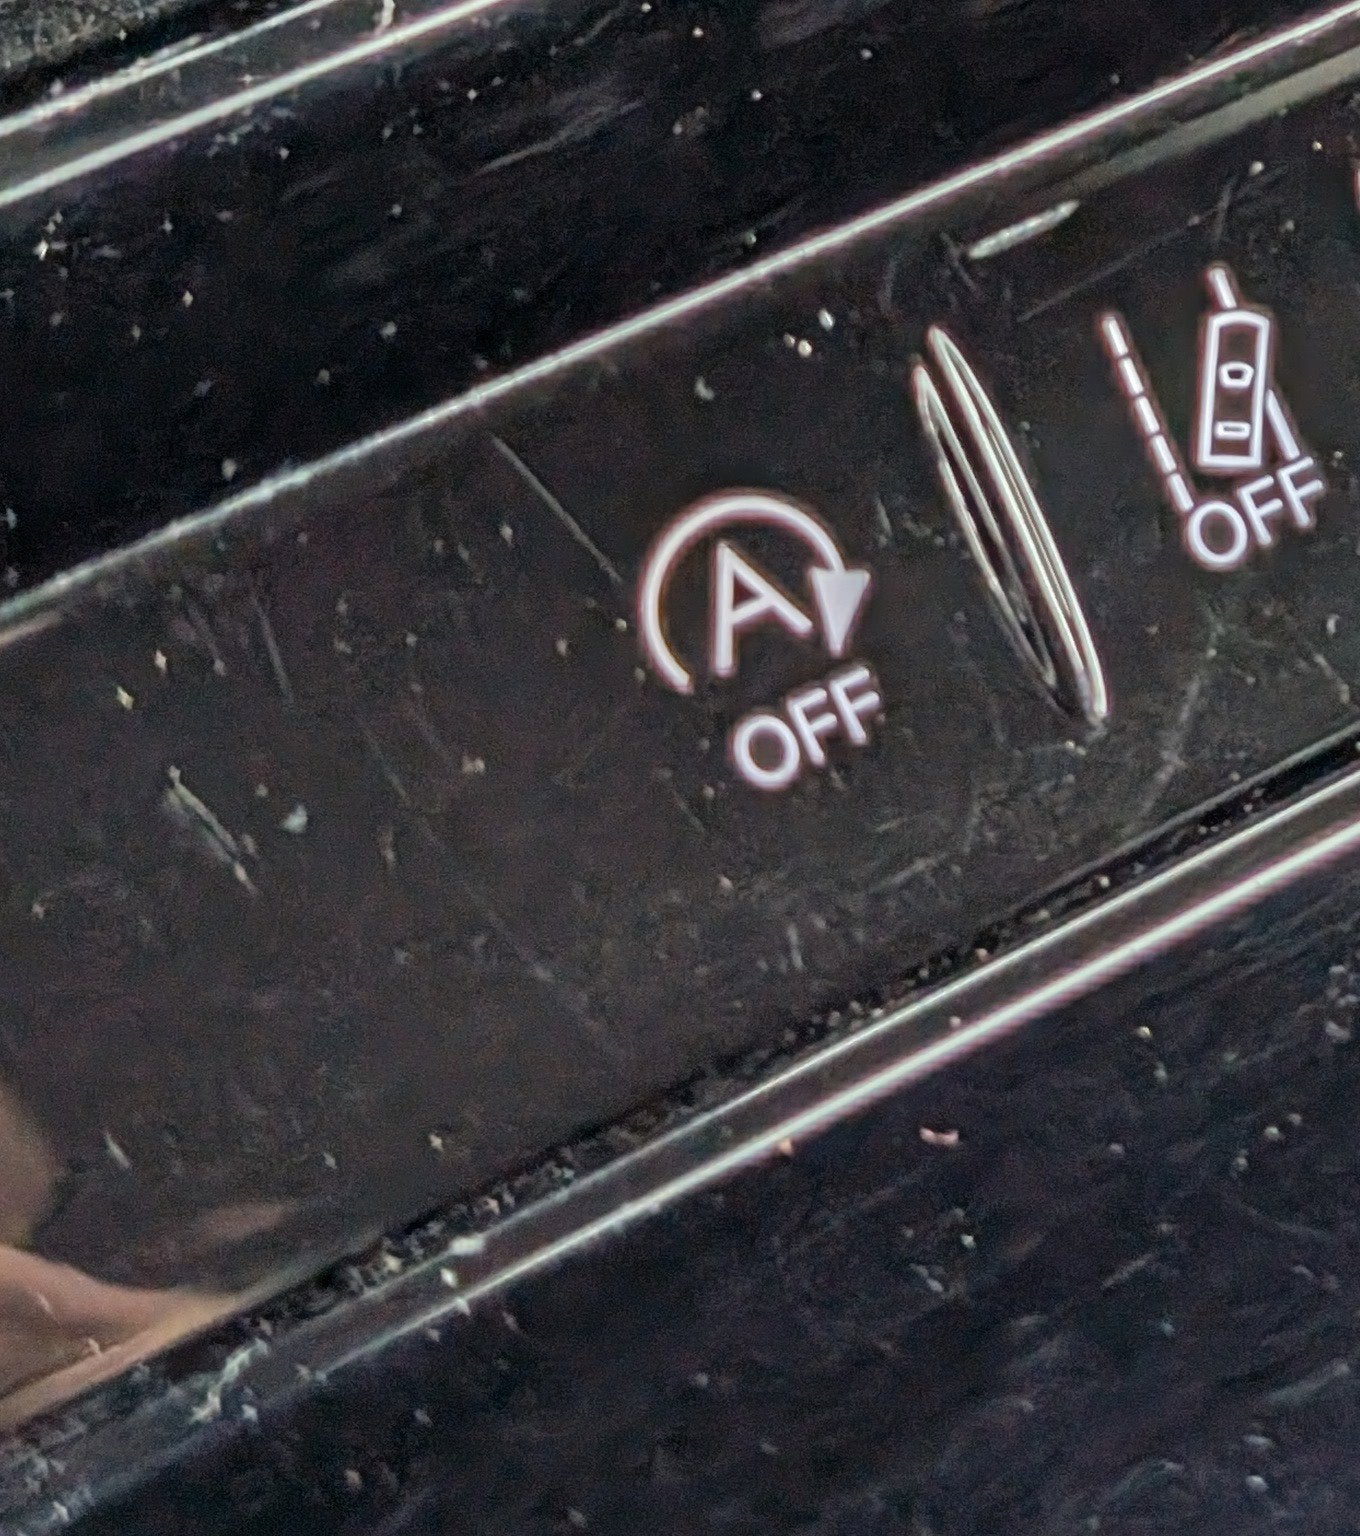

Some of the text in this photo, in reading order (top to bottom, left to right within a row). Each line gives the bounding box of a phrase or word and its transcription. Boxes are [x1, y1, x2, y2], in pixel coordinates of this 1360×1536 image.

[1187, 456, 1324, 564] OFF
[713, 540, 814, 676] A
[732, 666, 881, 789] OFF
